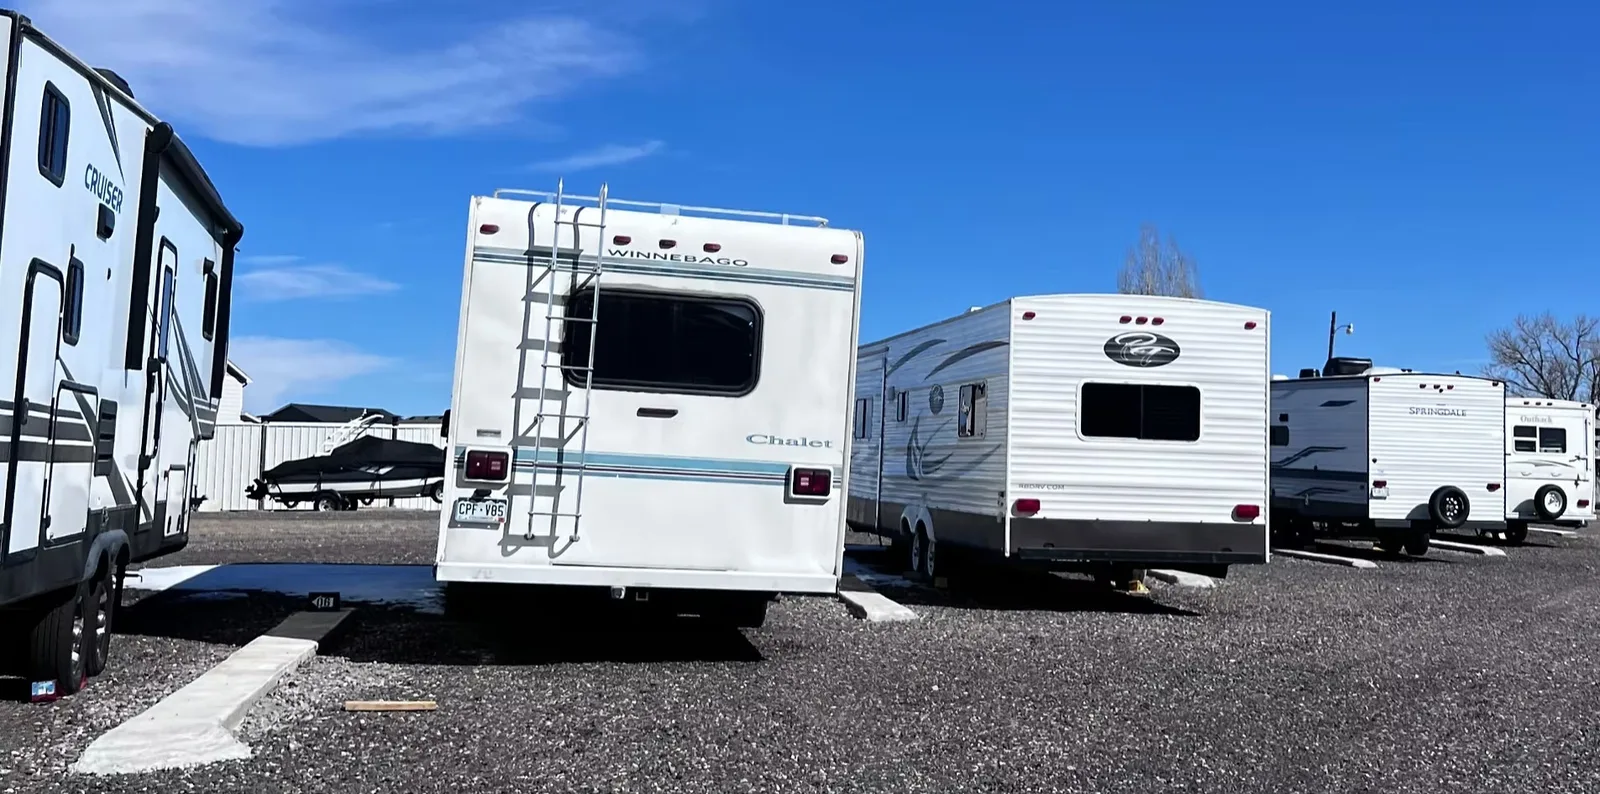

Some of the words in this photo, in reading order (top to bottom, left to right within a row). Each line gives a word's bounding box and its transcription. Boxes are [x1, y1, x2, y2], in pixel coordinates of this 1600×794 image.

[84, 162, 123, 214] CRUISER
[607, 248, 749, 267] WINNEBAGO
[1408, 406, 1468, 417] SPRINGDALE
[745, 433, 833, 449] Chalet
